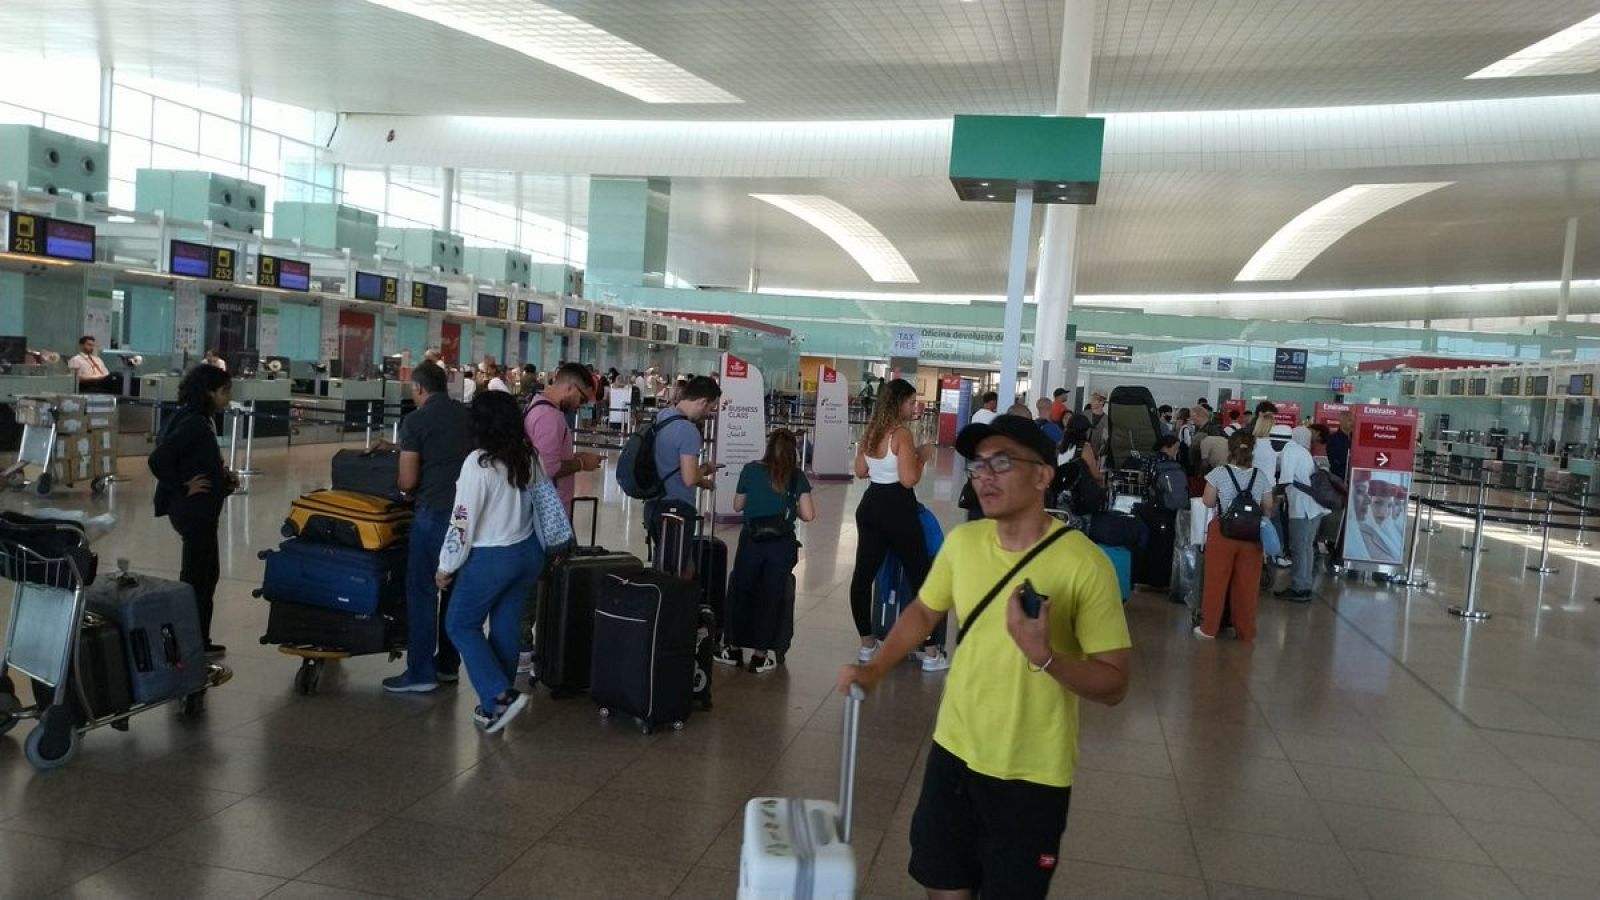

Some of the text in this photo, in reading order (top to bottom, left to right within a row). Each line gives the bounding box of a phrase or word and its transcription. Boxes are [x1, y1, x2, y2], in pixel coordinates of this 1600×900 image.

[15, 237, 36, 253] 251
[215, 267, 232, 280] 252
[898, 332, 914, 341] TAX
[921, 328, 951, 338] Oficina
[895, 341, 917, 350] FREE
[728, 405, 759, 413] BUSINESS
[1363, 406, 1397, 416] Emirates
